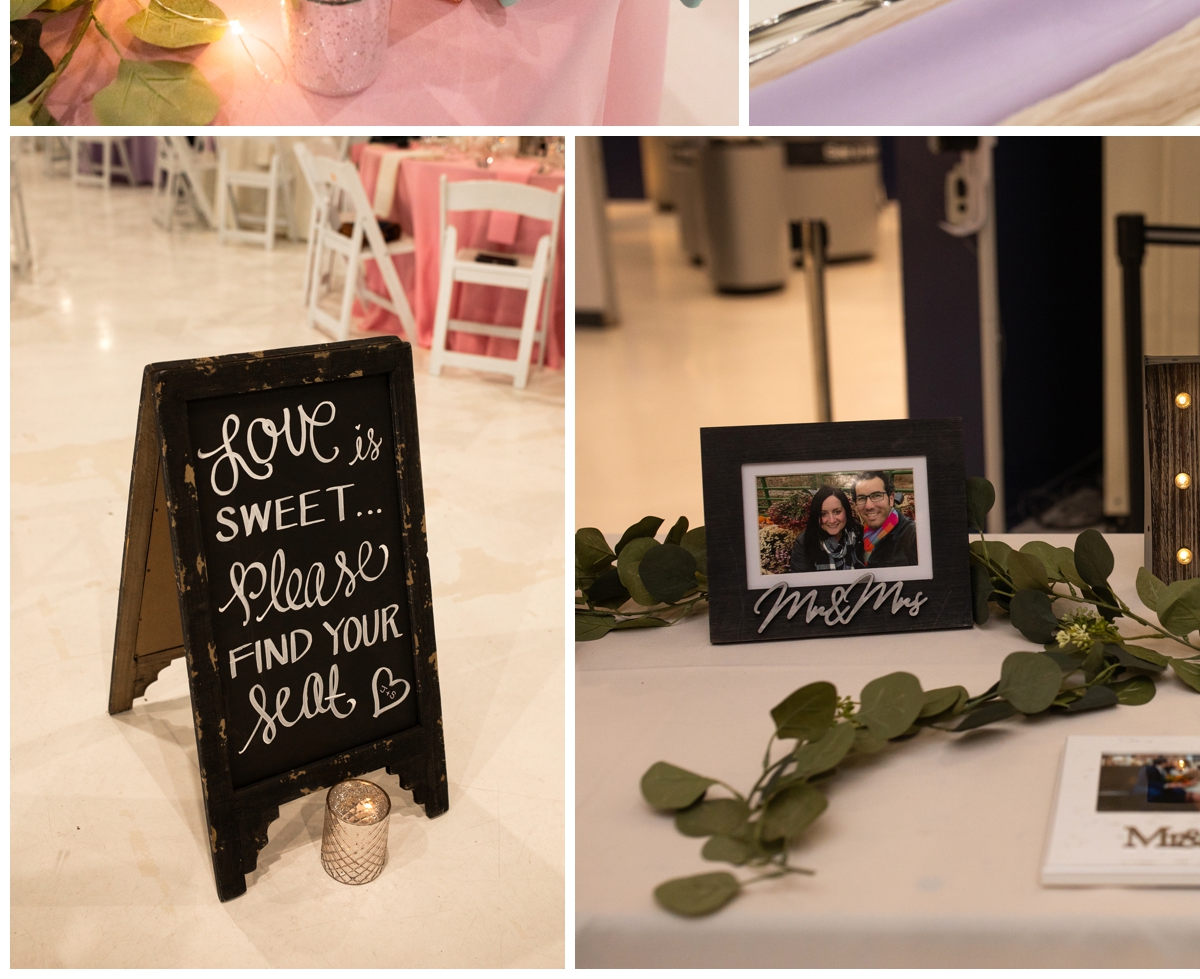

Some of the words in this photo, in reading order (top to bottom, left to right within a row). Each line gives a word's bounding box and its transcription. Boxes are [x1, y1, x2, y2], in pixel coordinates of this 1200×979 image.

[215, 483, 382, 542] SWEET...
[218, 540, 390, 627] Please
[228, 628, 313, 680] FIND
[322, 603, 403, 656] YOUR
